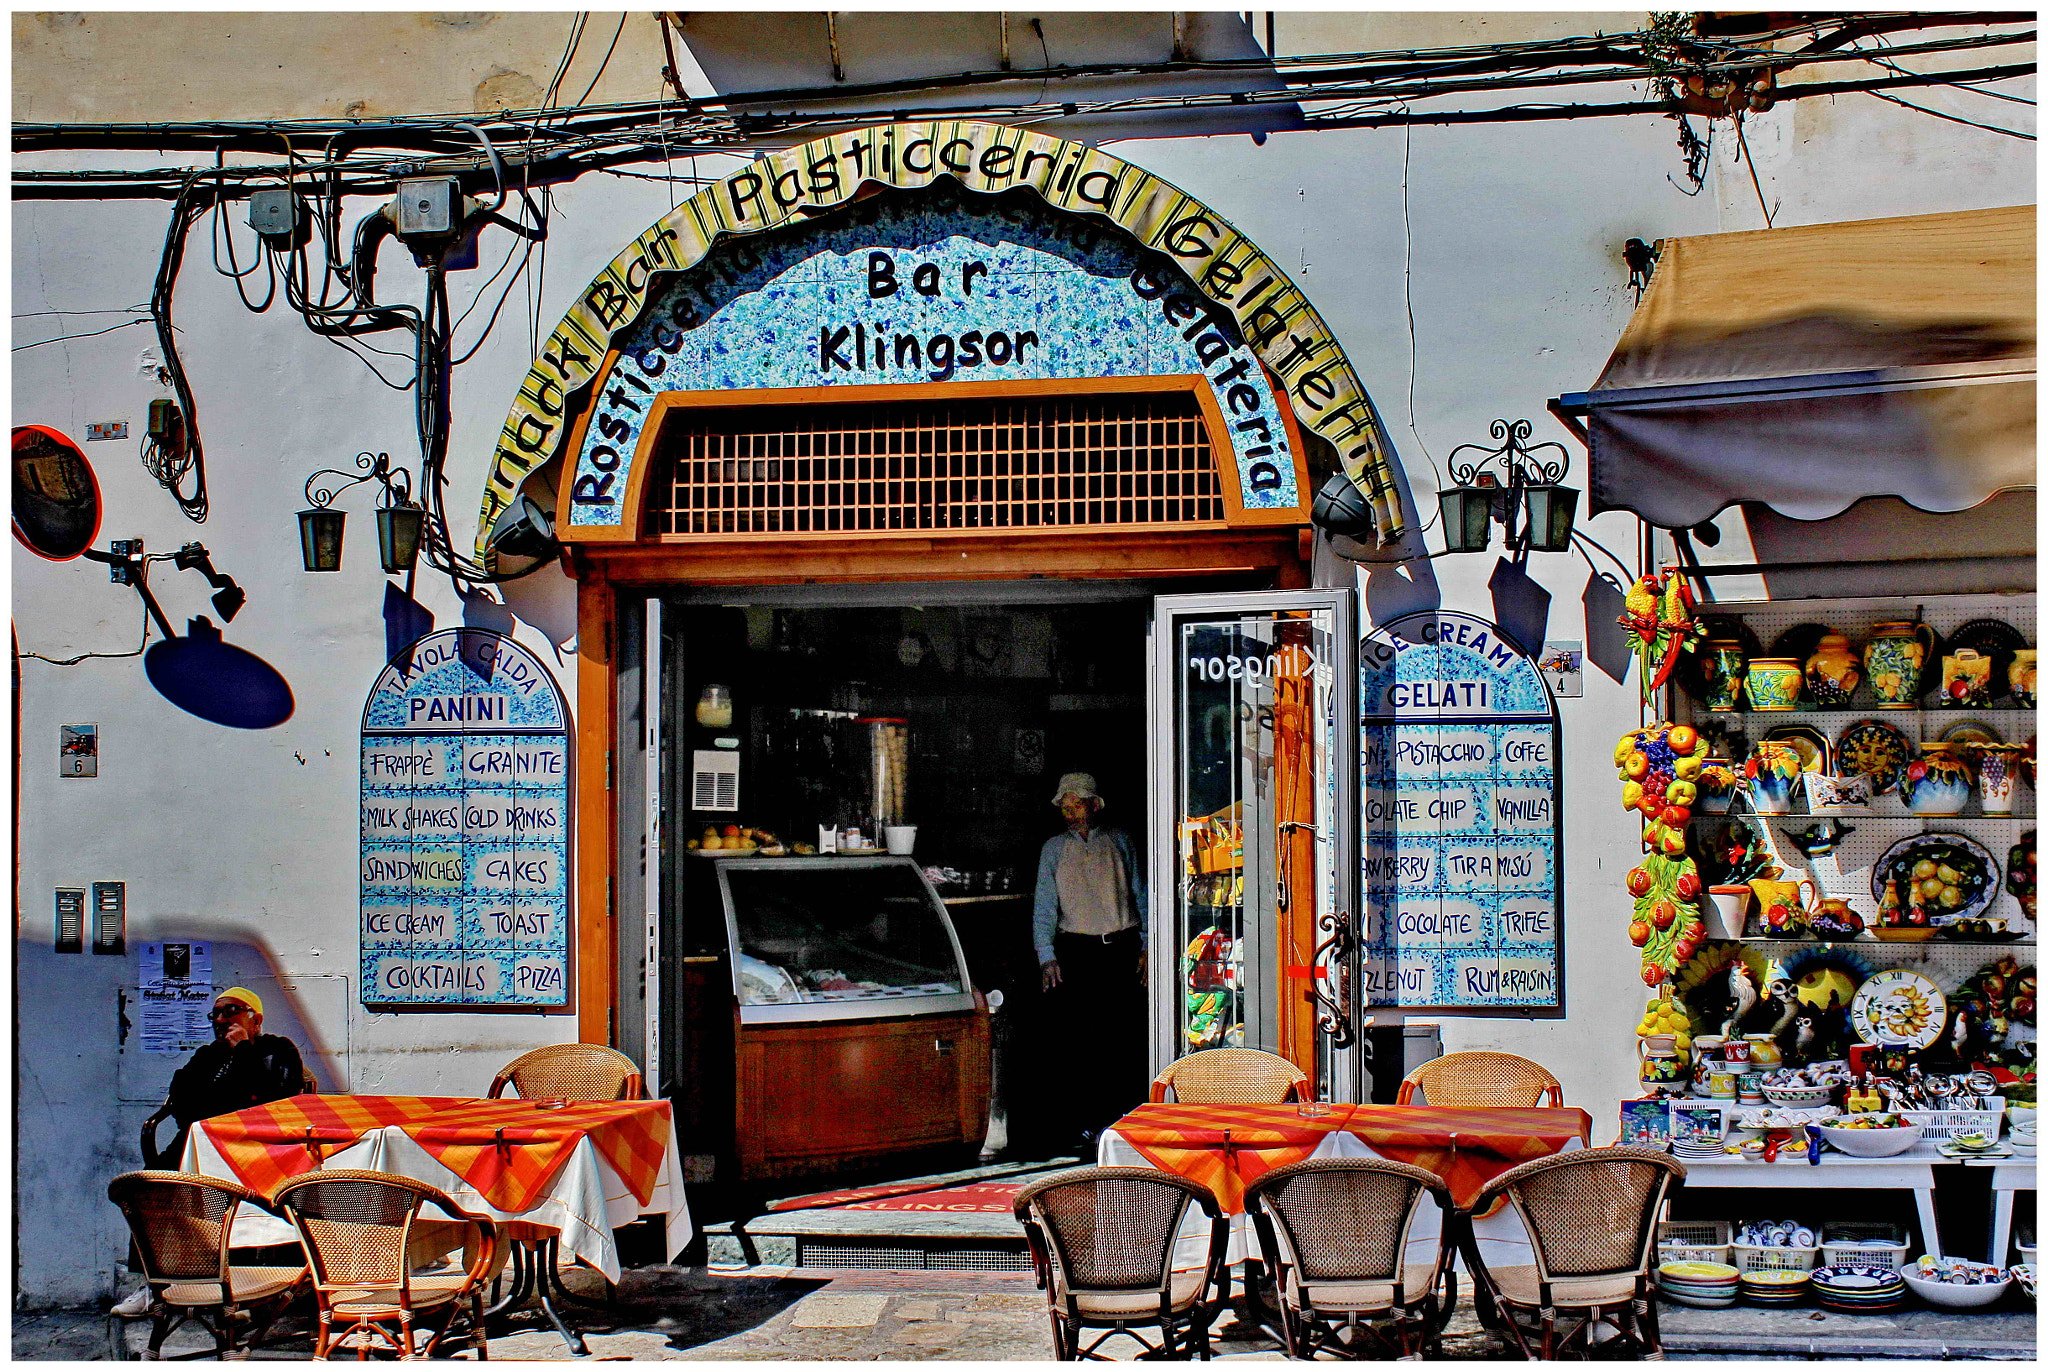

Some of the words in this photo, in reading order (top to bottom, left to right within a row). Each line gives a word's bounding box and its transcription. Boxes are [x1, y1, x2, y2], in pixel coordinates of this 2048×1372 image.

[866, 250, 989, 300] Bar
[584, 228, 680, 332] Bar
[727, 131, 1118, 221] Pasticceria
[1164, 215, 1387, 499] Gelateria
[819, 323, 1040, 382] Klingsor
[571, 240, 763, 507] Rosticceria
[1363, 631, 1410, 671] ICE
[1420, 622, 1514, 669] CREAM
[387, 640, 464, 693] TAVOLA
[477, 643, 538, 694] CALDA
[1386, 683, 1487, 708] GELATI
[1556, 678, 1565, 693] 4
[409, 696, 504, 722] PANINI
[369, 749, 434, 776] FRAPPÈ
[468, 751, 562, 775] GRANITE
[1396, 740, 1485, 766] PISTACCHIO
[1505, 740, 1549, 763] COFFE
[75, 759, 83, 773] 6
[366, 807, 399, 829] MILK
[402, 806, 458, 831] SHAKES
[464, 805, 499, 829] COLD
[506, 806, 557, 832] DRINKS
[1362, 799, 1420, 823] COLATE
[1428, 798, 1467, 822] CHIP
[1497, 798, 1550, 826] VANILLA
[363, 856, 463, 882] SANDWICHES
[485, 860, 548, 884] CAKES
[366, 913, 391, 934] ICE
[395, 913, 445, 936] CREAM
[489, 911, 550, 935] TOAST
[1397, 911, 1472, 936] COCOLATE
[1501, 911, 1551, 936] TRIFLE
[386, 964, 486, 991] COCKTAILS
[516, 964, 562, 991] PIZZA
[1465, 966, 1499, 997] RUM
[845, 1203, 1015, 1212] KLINGS
